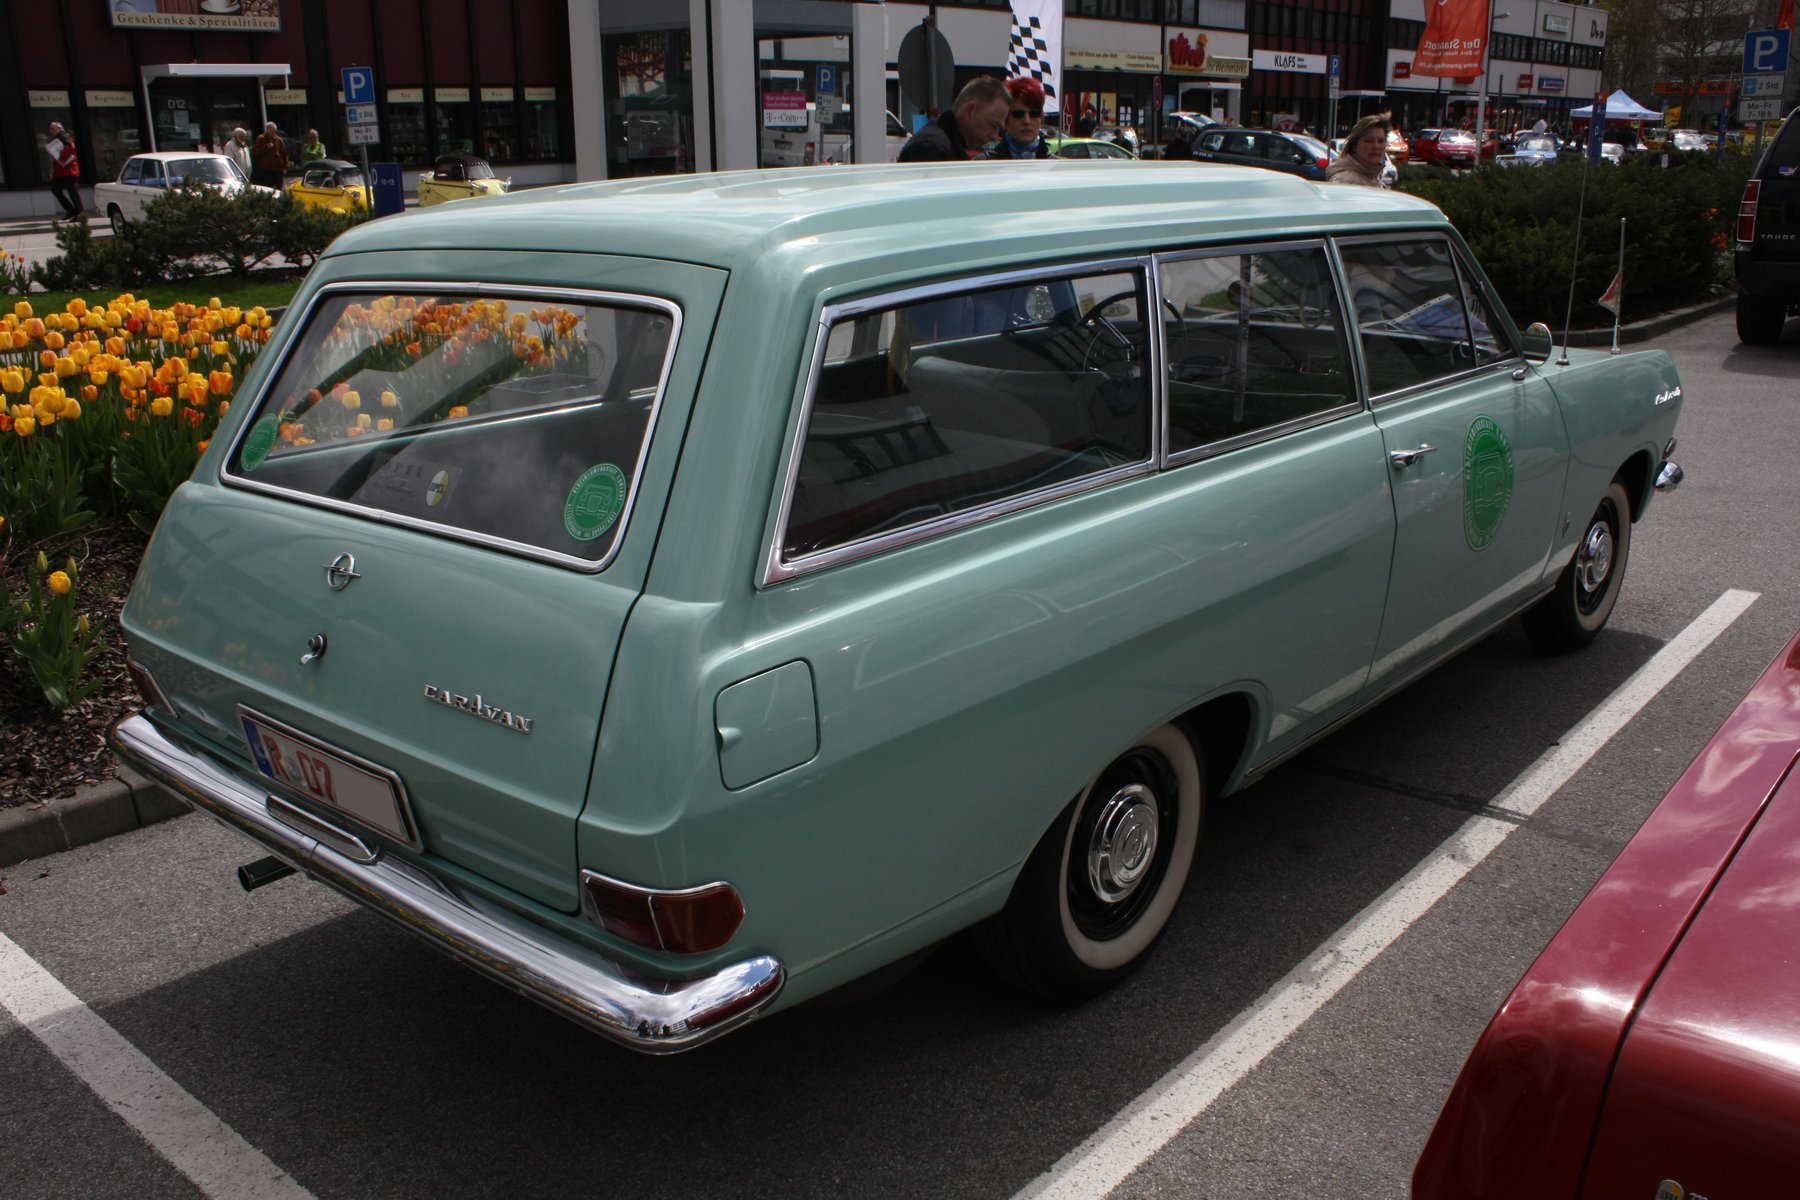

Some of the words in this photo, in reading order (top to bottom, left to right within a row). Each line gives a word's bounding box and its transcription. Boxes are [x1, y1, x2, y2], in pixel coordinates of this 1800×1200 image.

[117, 13, 185, 25] Geschenke
[187, 16, 197, 25] &
[199, 16, 277, 29] Spezialitäten
[1274, 54, 1296, 68] KLAFS
[1753, 35, 1779, 68] P
[1332, 58, 1339, 74] P
[349, 72, 366, 99] P
[821, 68, 831, 90] P
[94, 95, 127, 103] Regional
[167, 99, 186, 110] D12
[424, 684, 533, 735] CARAVAN
[263, 735, 291, 782] R
